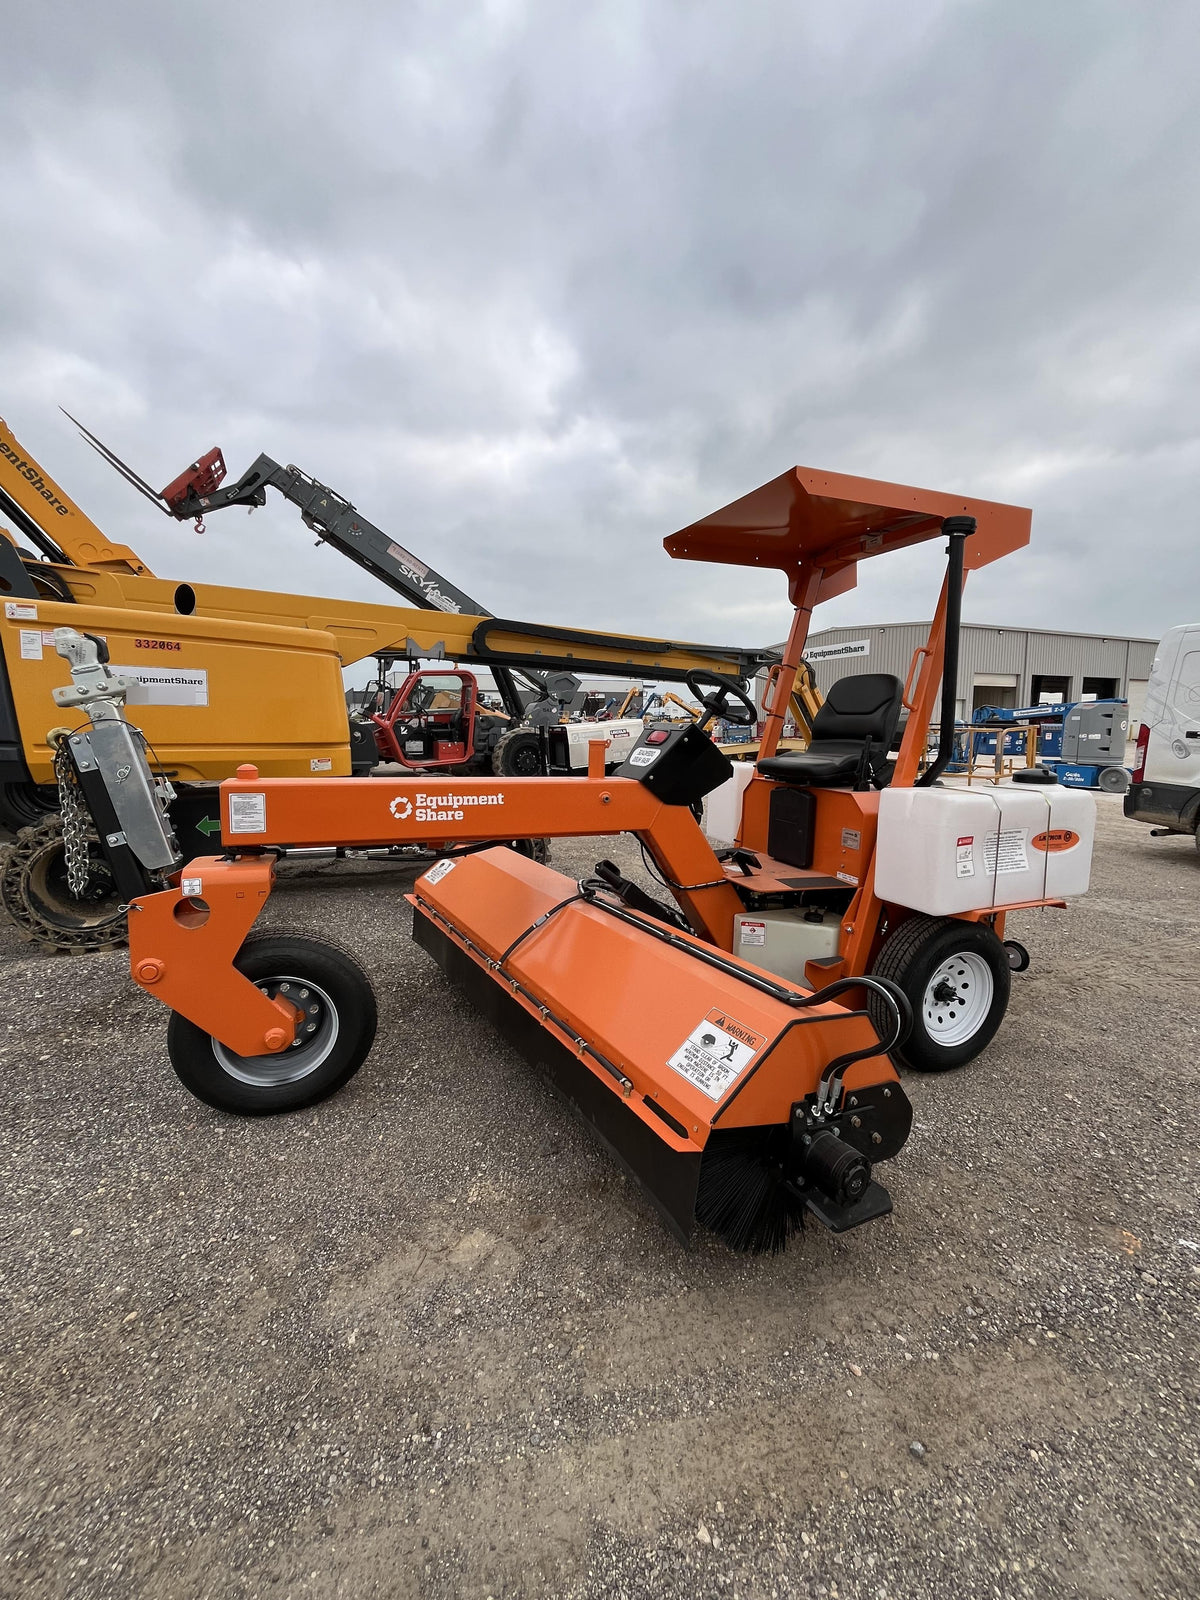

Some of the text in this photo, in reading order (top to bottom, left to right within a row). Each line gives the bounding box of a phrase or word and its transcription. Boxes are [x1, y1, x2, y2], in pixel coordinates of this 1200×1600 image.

[0, 437, 68, 516] entShare
[135, 639, 181, 651] 332064
[809, 645, 865, 659] EquipmentShare
[416, 793, 504, 809] Equipment
[416, 808, 464, 821] Share
[725, 1022, 757, 1045] WARNING
[684, 1047, 699, 1059] MINIMUM
[698, 1057, 715, 1071] DISTANCE
[689, 1044, 701, 1054] STAND
[700, 1051, 712, 1062] CLEAR
[684, 1054, 693, 1062] WHEN
[692, 1060, 708, 1072] MACHINE
[685, 1062, 705, 1078] OPERATION
[676, 1062, 690, 1073] ENGINE
[694, 1075, 711, 1090] RUNNING
